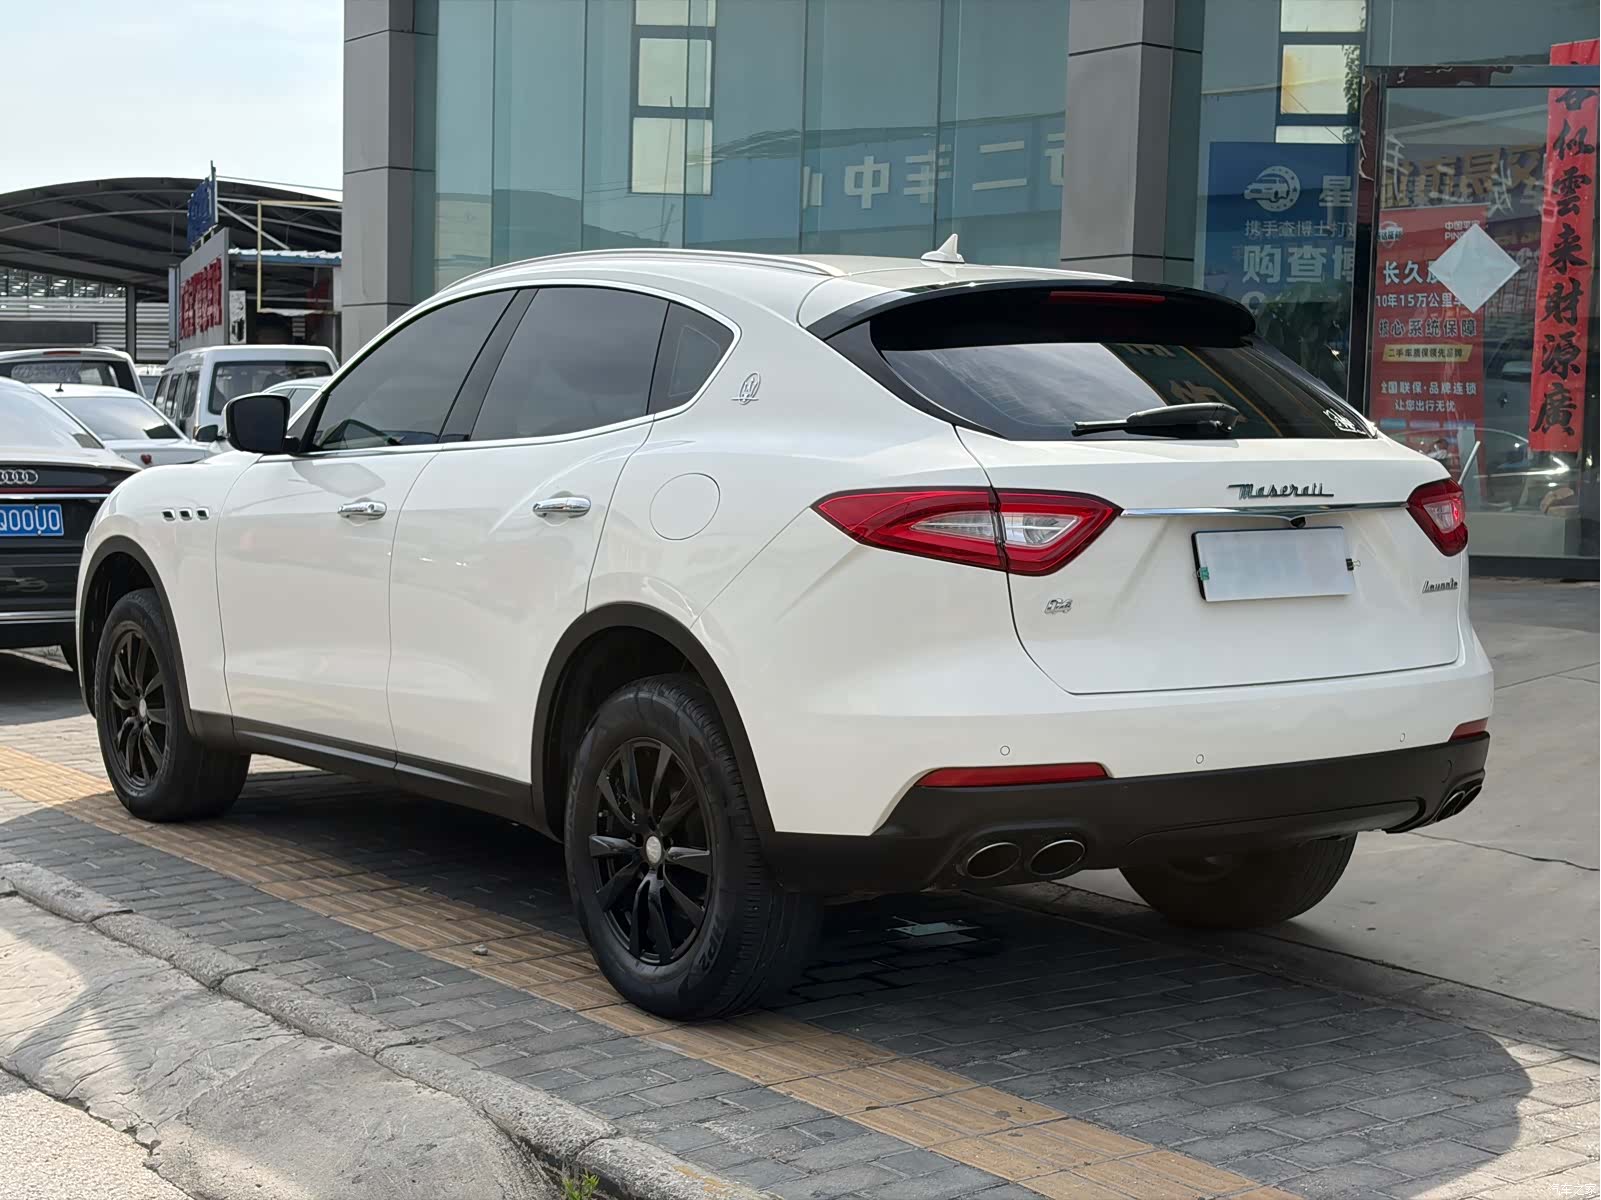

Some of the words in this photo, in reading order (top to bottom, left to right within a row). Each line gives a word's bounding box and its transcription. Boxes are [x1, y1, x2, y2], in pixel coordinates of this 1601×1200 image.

[1379, 318, 1477, 337] 核心系统保障
[1395, 399, 1456, 412] 让您出行无忧
[1226, 483, 1335, 500] Maserati
